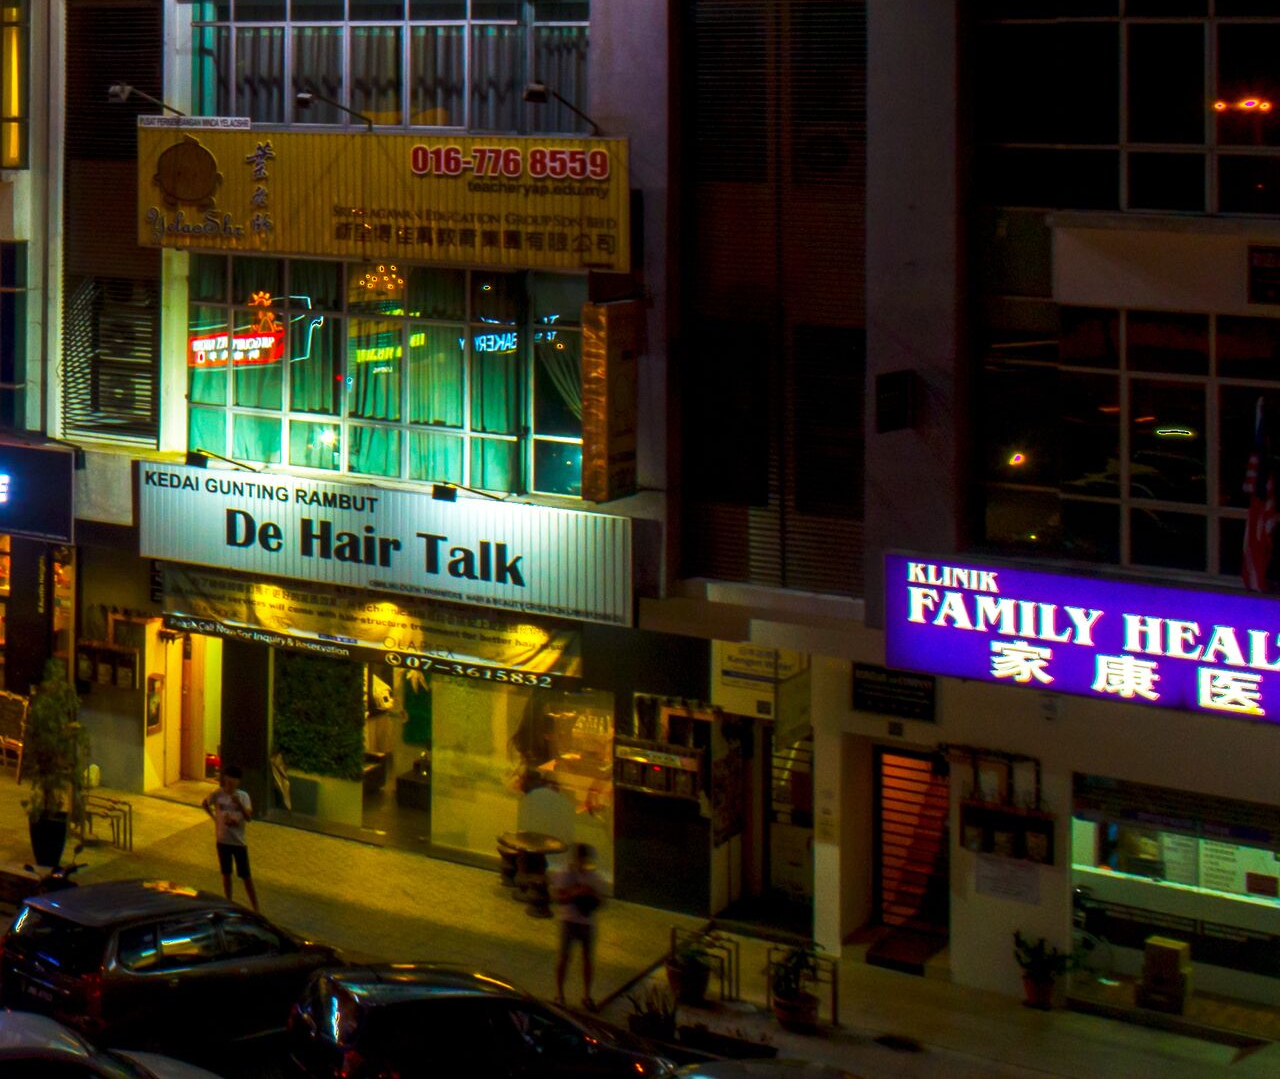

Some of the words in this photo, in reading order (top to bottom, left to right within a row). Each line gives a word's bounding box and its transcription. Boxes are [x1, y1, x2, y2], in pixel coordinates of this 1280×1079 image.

[410, 144, 522, 177] 016-776
[528, 146, 611, 180] 8559
[467, 179, 610, 199] teacheryap.edu.my
[145, 469, 200, 493] KEDAI
[205, 476, 289, 504] GUNTING
[294, 488, 379, 515] RAMBUT
[225, 507, 284, 553] De
[299, 517, 403, 568] Hair
[416, 531, 527, 588] Talk
[906, 561, 1000, 594] KLINIK
[198, 620, 216, 632] Call
[252, 630, 286, 648] Inquiry
[295, 639, 350, 656] Reservation
[269, 601, 285, 612] will
[360, 615, 408, 631] structure
[479, 632, 513, 646] better
[906, 585, 1105, 648] FAMILY
[1121, 612, 1280, 672] HEAL
[405, 655, 553, 689] 07-3615832
[988, 640, 1267, 716] 家康医
